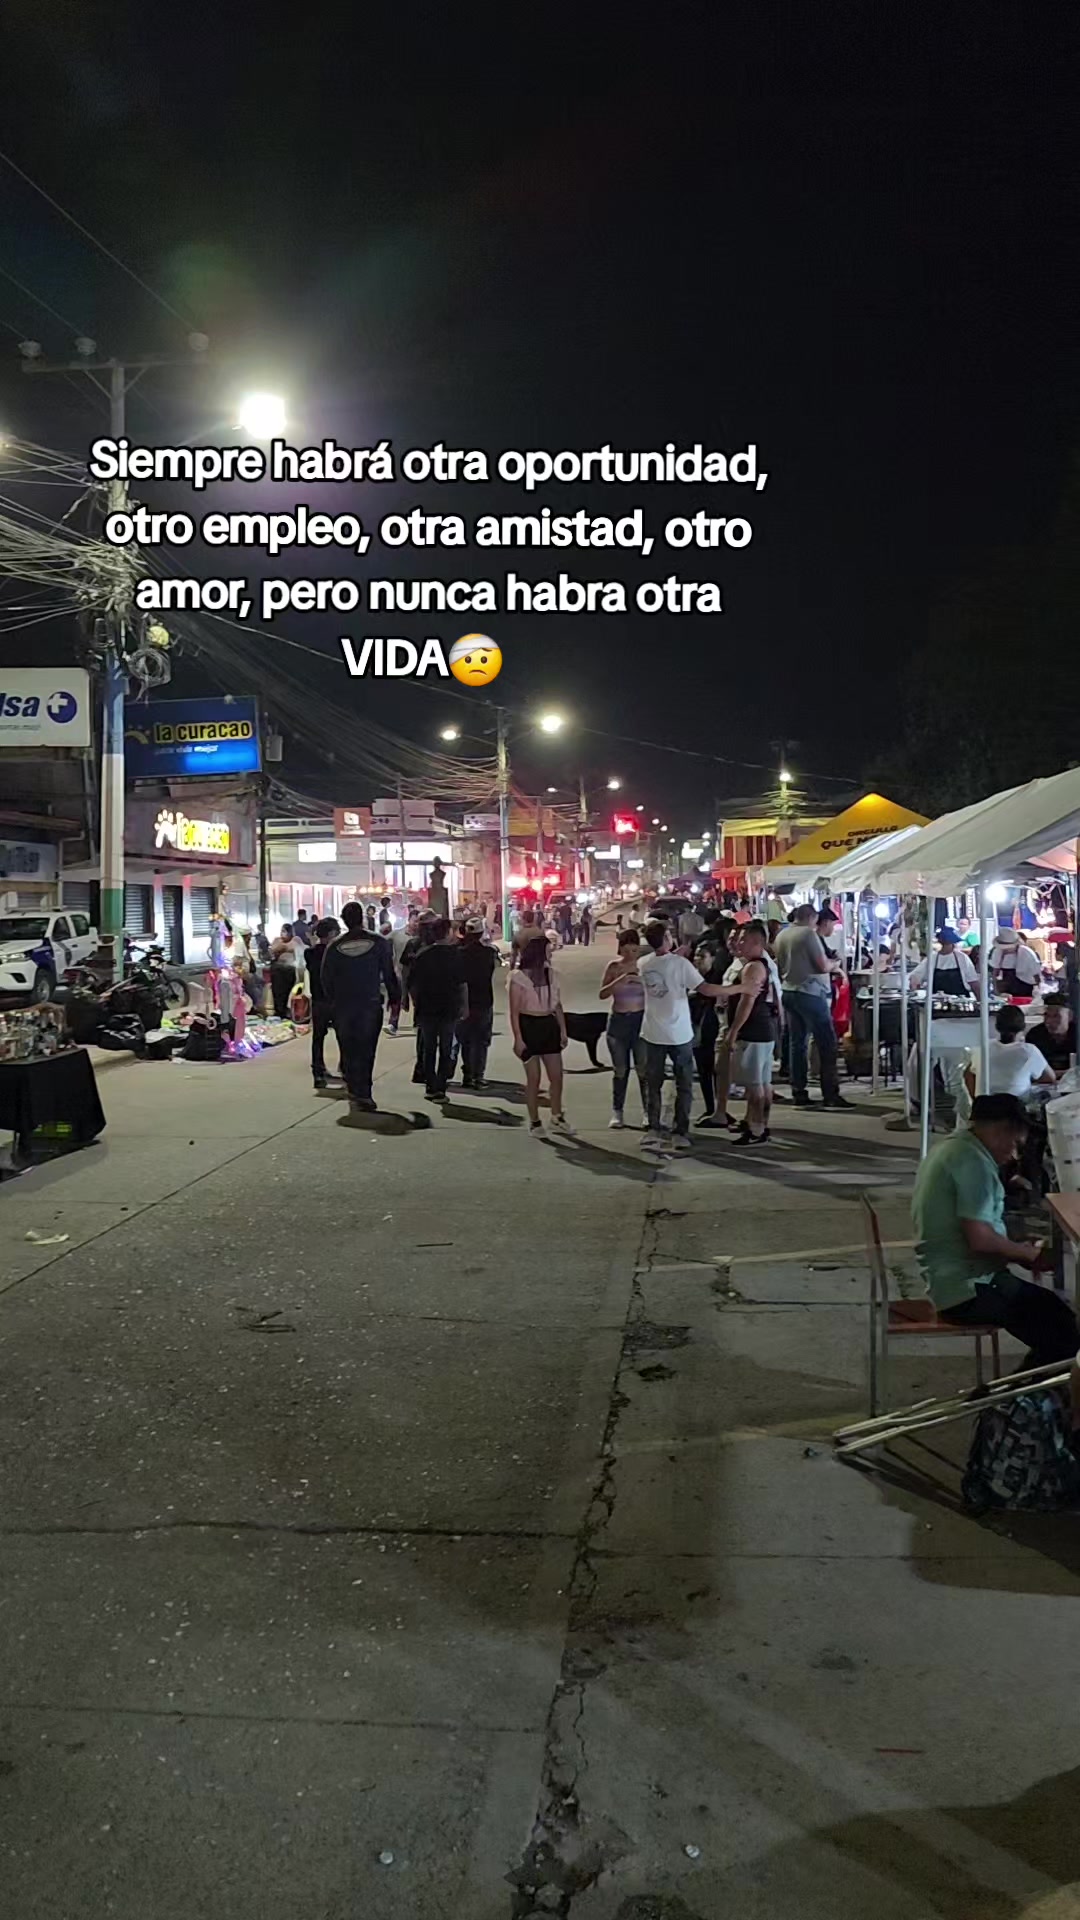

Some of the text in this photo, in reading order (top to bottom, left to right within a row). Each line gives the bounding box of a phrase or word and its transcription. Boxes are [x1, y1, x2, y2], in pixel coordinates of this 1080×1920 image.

[155, 721, 252, 742] la curacao
[821, 838, 854, 850] QUE
